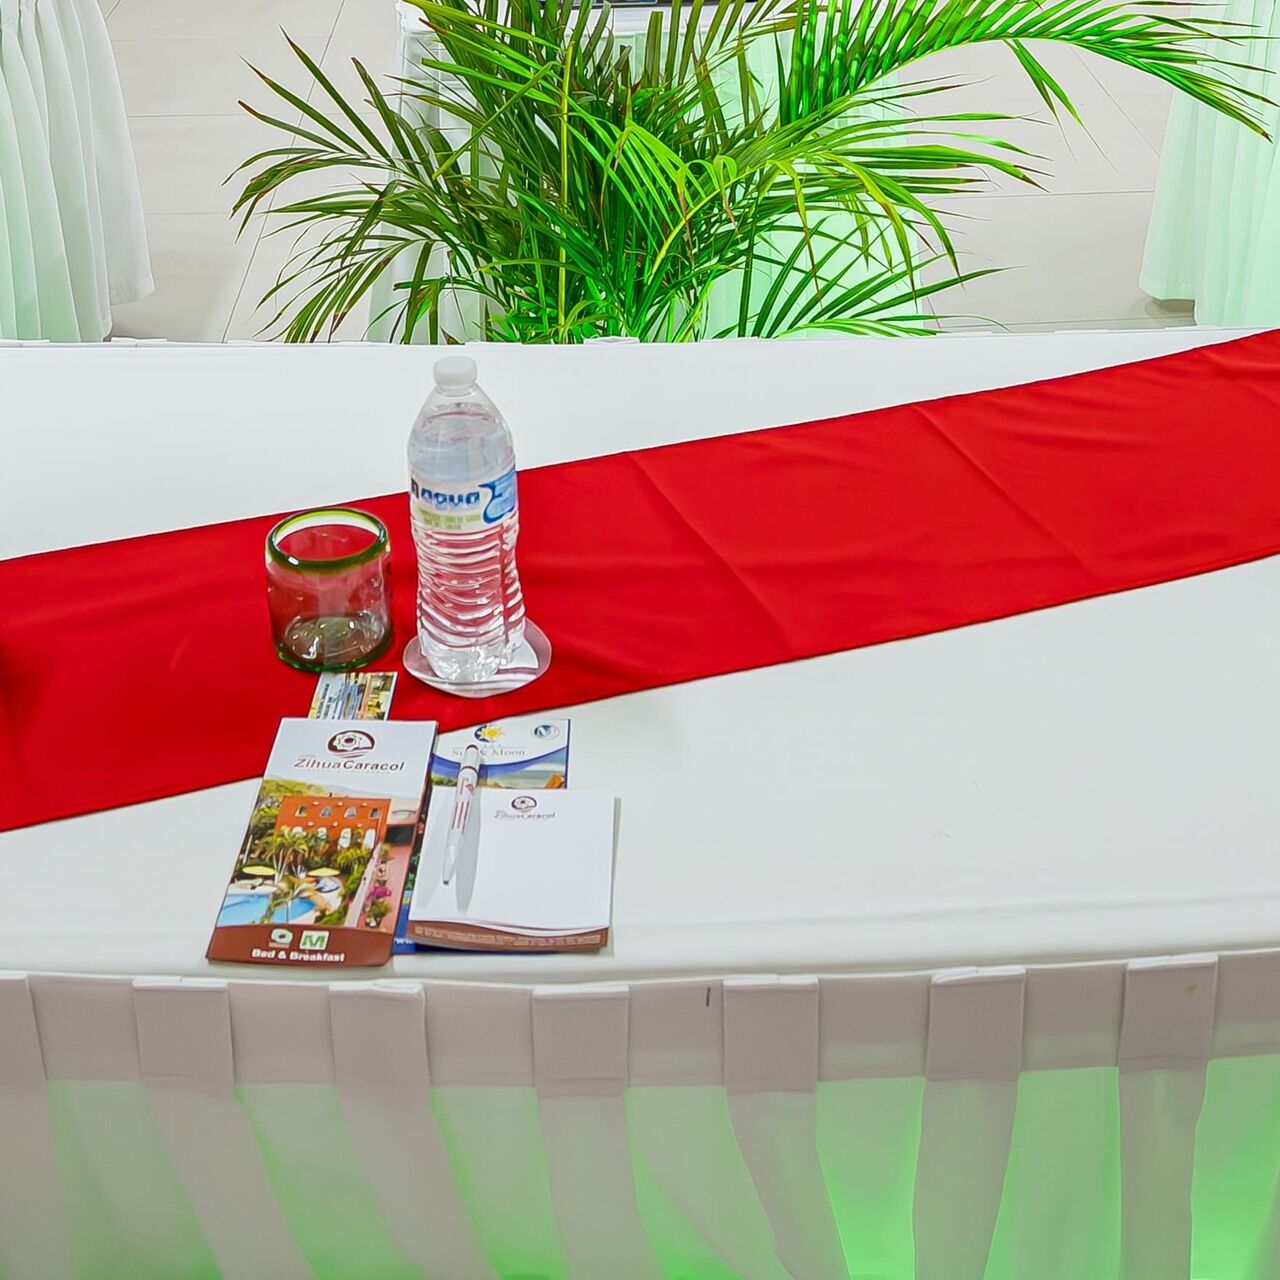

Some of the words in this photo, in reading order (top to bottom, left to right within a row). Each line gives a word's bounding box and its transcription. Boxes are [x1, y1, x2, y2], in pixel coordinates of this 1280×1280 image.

[421, 487, 480, 511] agua
[294, 757, 405, 772] ZihuaCaracol
[251, 948, 276, 959] Bed
[277, 949, 287, 960] &
[289, 951, 345, 962] Breakfast
